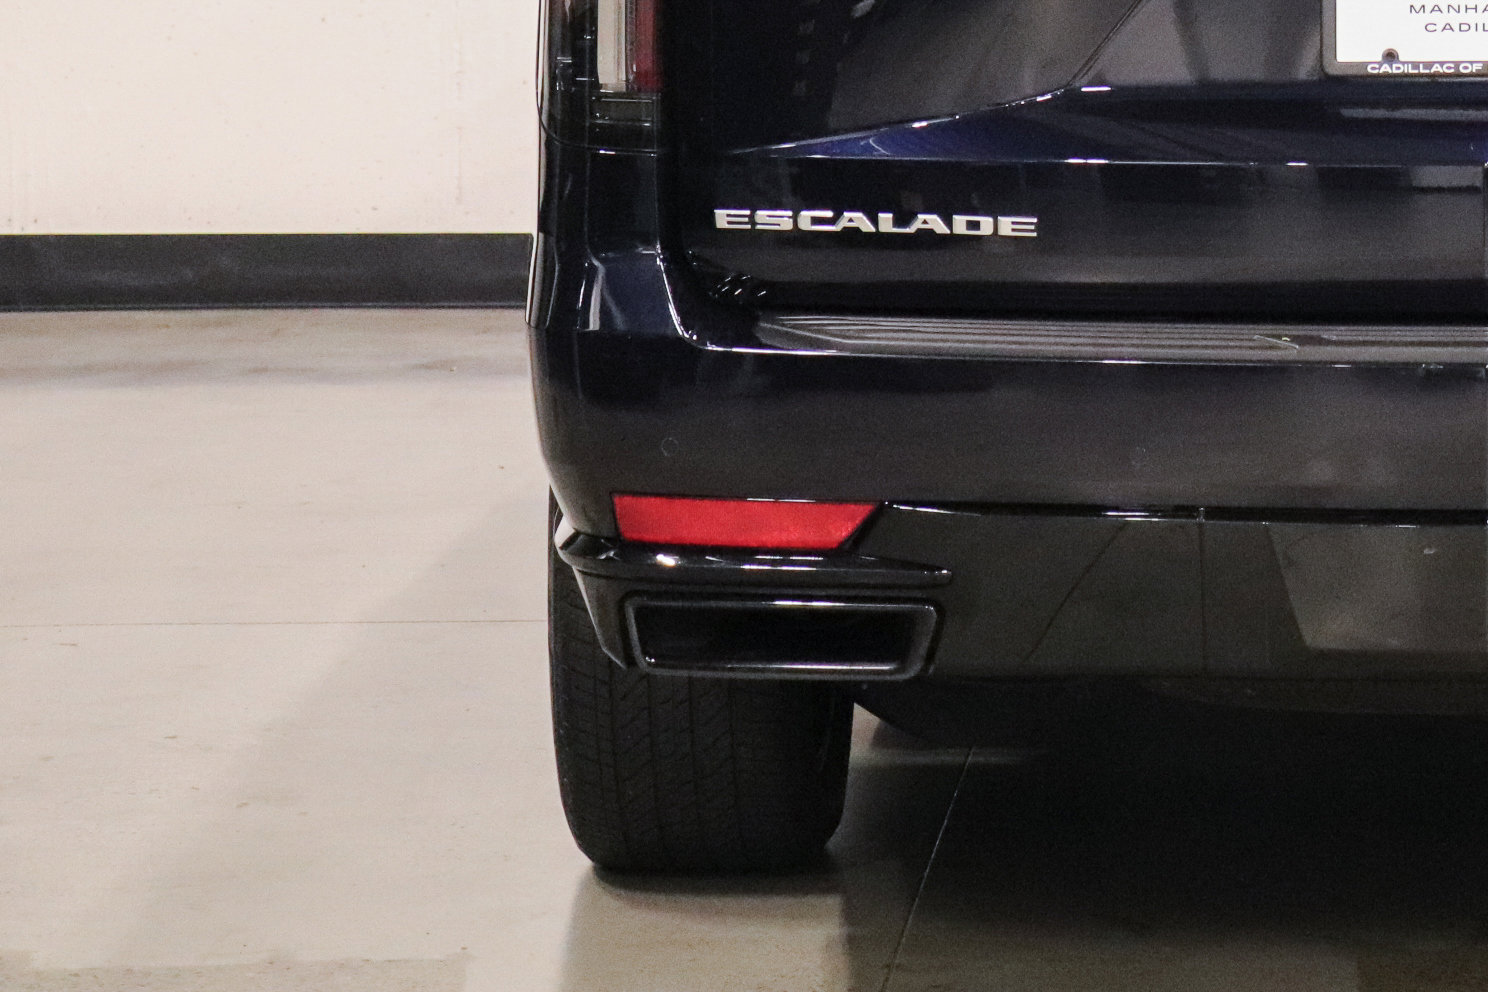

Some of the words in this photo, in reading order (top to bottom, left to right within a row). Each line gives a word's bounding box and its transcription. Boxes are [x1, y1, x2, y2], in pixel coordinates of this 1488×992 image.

[1367, 63, 1455, 74] CADILLAC
[1459, 63, 1483, 74] OF
[713, 209, 1038, 237] ESCALADE
